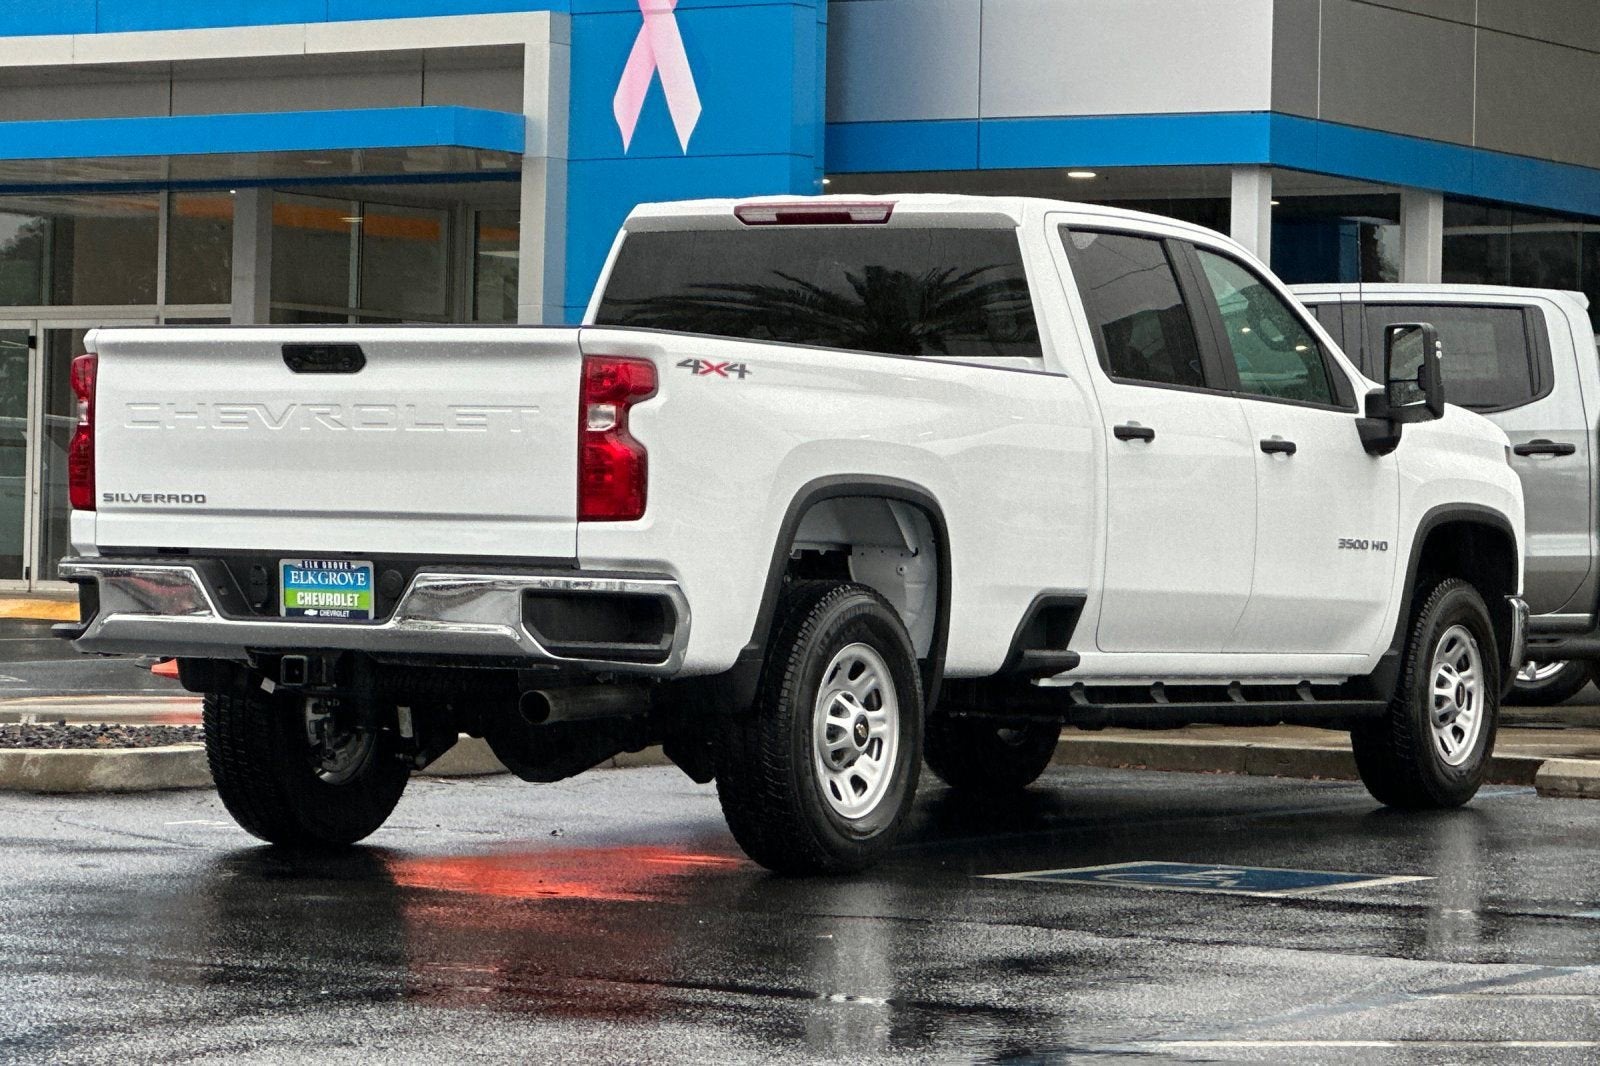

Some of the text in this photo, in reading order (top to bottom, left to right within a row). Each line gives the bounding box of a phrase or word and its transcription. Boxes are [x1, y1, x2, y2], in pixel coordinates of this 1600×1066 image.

[124, 402, 540, 433] CHEVROLET
[103, 493, 206, 504] SILVERADO
[1338, 538, 1388, 552] 3500 HD
[304, 560, 348, 570] ELK GROVE
[290, 571, 366, 585] ELK GROVE
[296, 591, 360, 607] CHEVROLET
[319, 609, 350, 618] CHEVROLET
